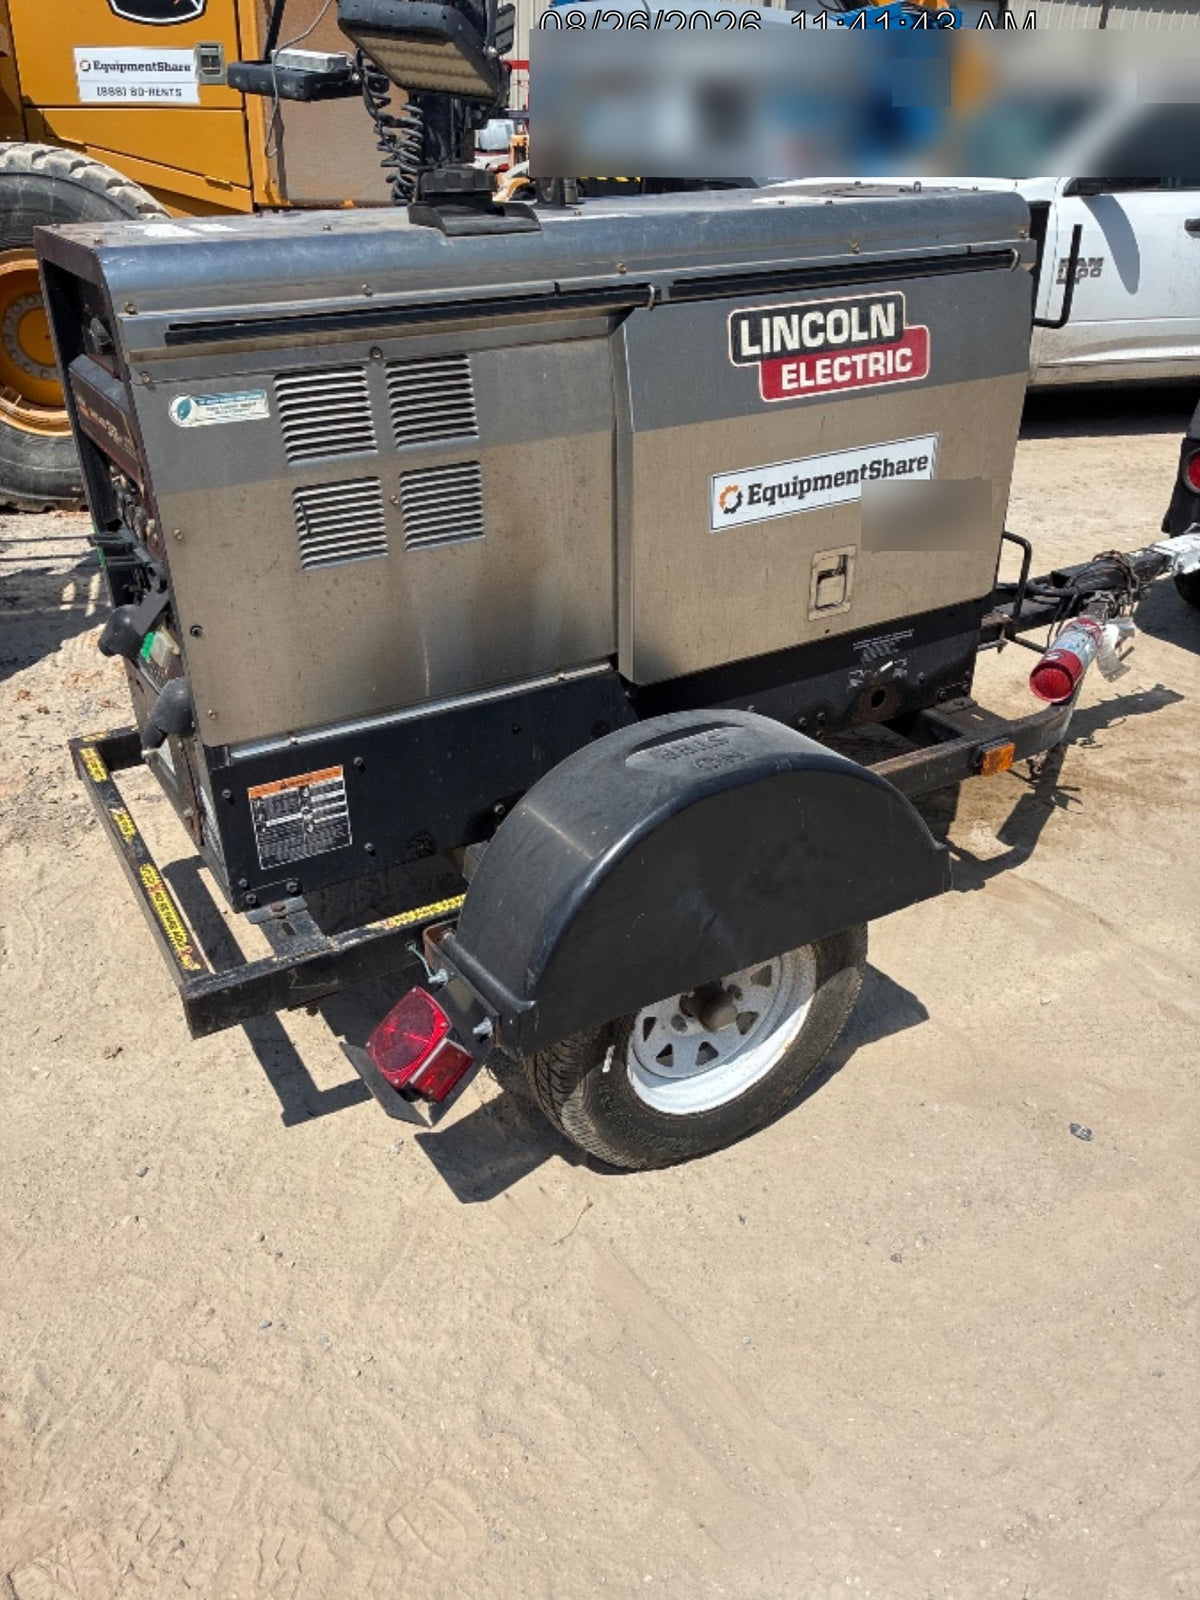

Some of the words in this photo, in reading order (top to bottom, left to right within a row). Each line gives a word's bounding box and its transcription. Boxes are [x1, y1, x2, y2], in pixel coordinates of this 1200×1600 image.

[93, 60, 192, 74] EquipmentShare
[740, 302, 896, 356] LINCOLN
[781, 348, 913, 391] ELECTRIC
[747, 454, 929, 506] EquipmentShare
